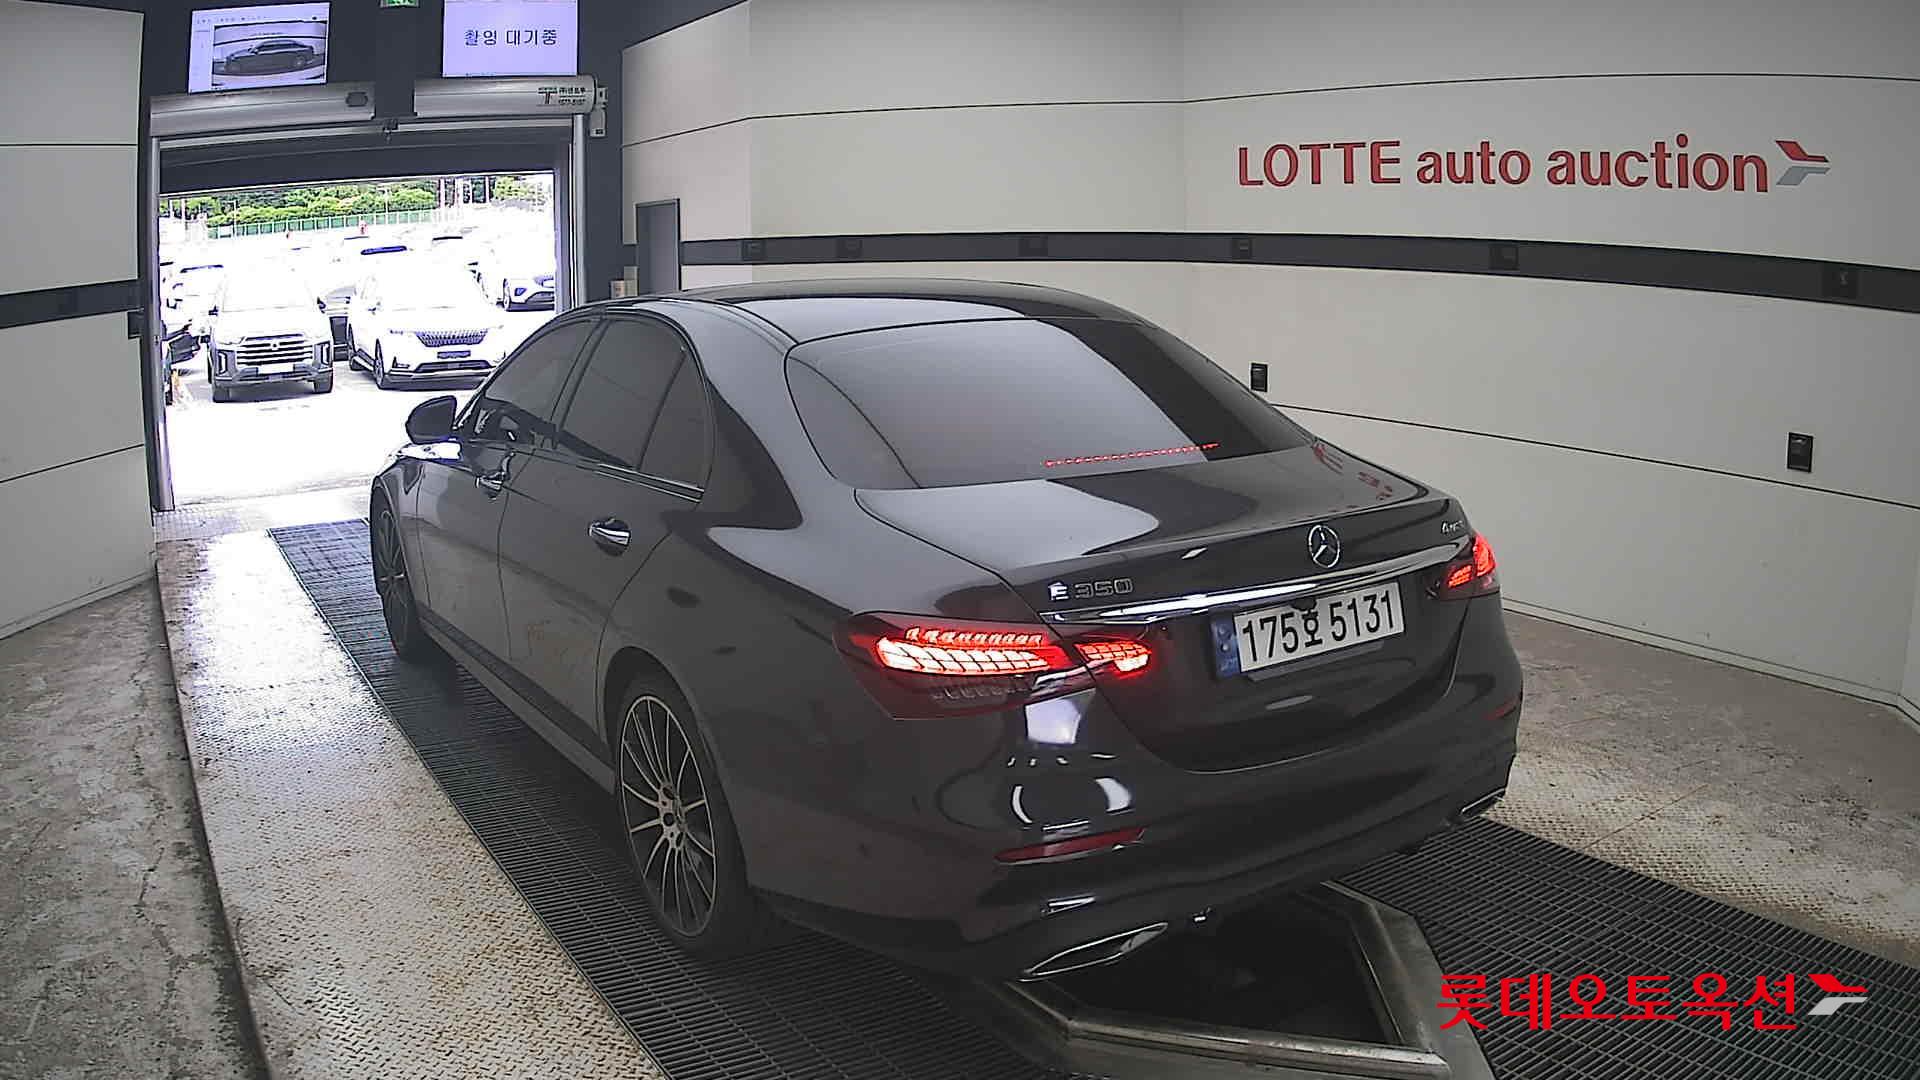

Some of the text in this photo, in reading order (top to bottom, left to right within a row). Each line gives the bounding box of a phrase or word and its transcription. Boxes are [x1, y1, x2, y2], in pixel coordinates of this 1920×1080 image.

[506, 29, 557, 46] 대기중
[1238, 133, 1769, 193] LOTTE auto auction
[1048, 578, 1134, 600] E 350
[1242, 590, 1394, 662] 175호 5131
